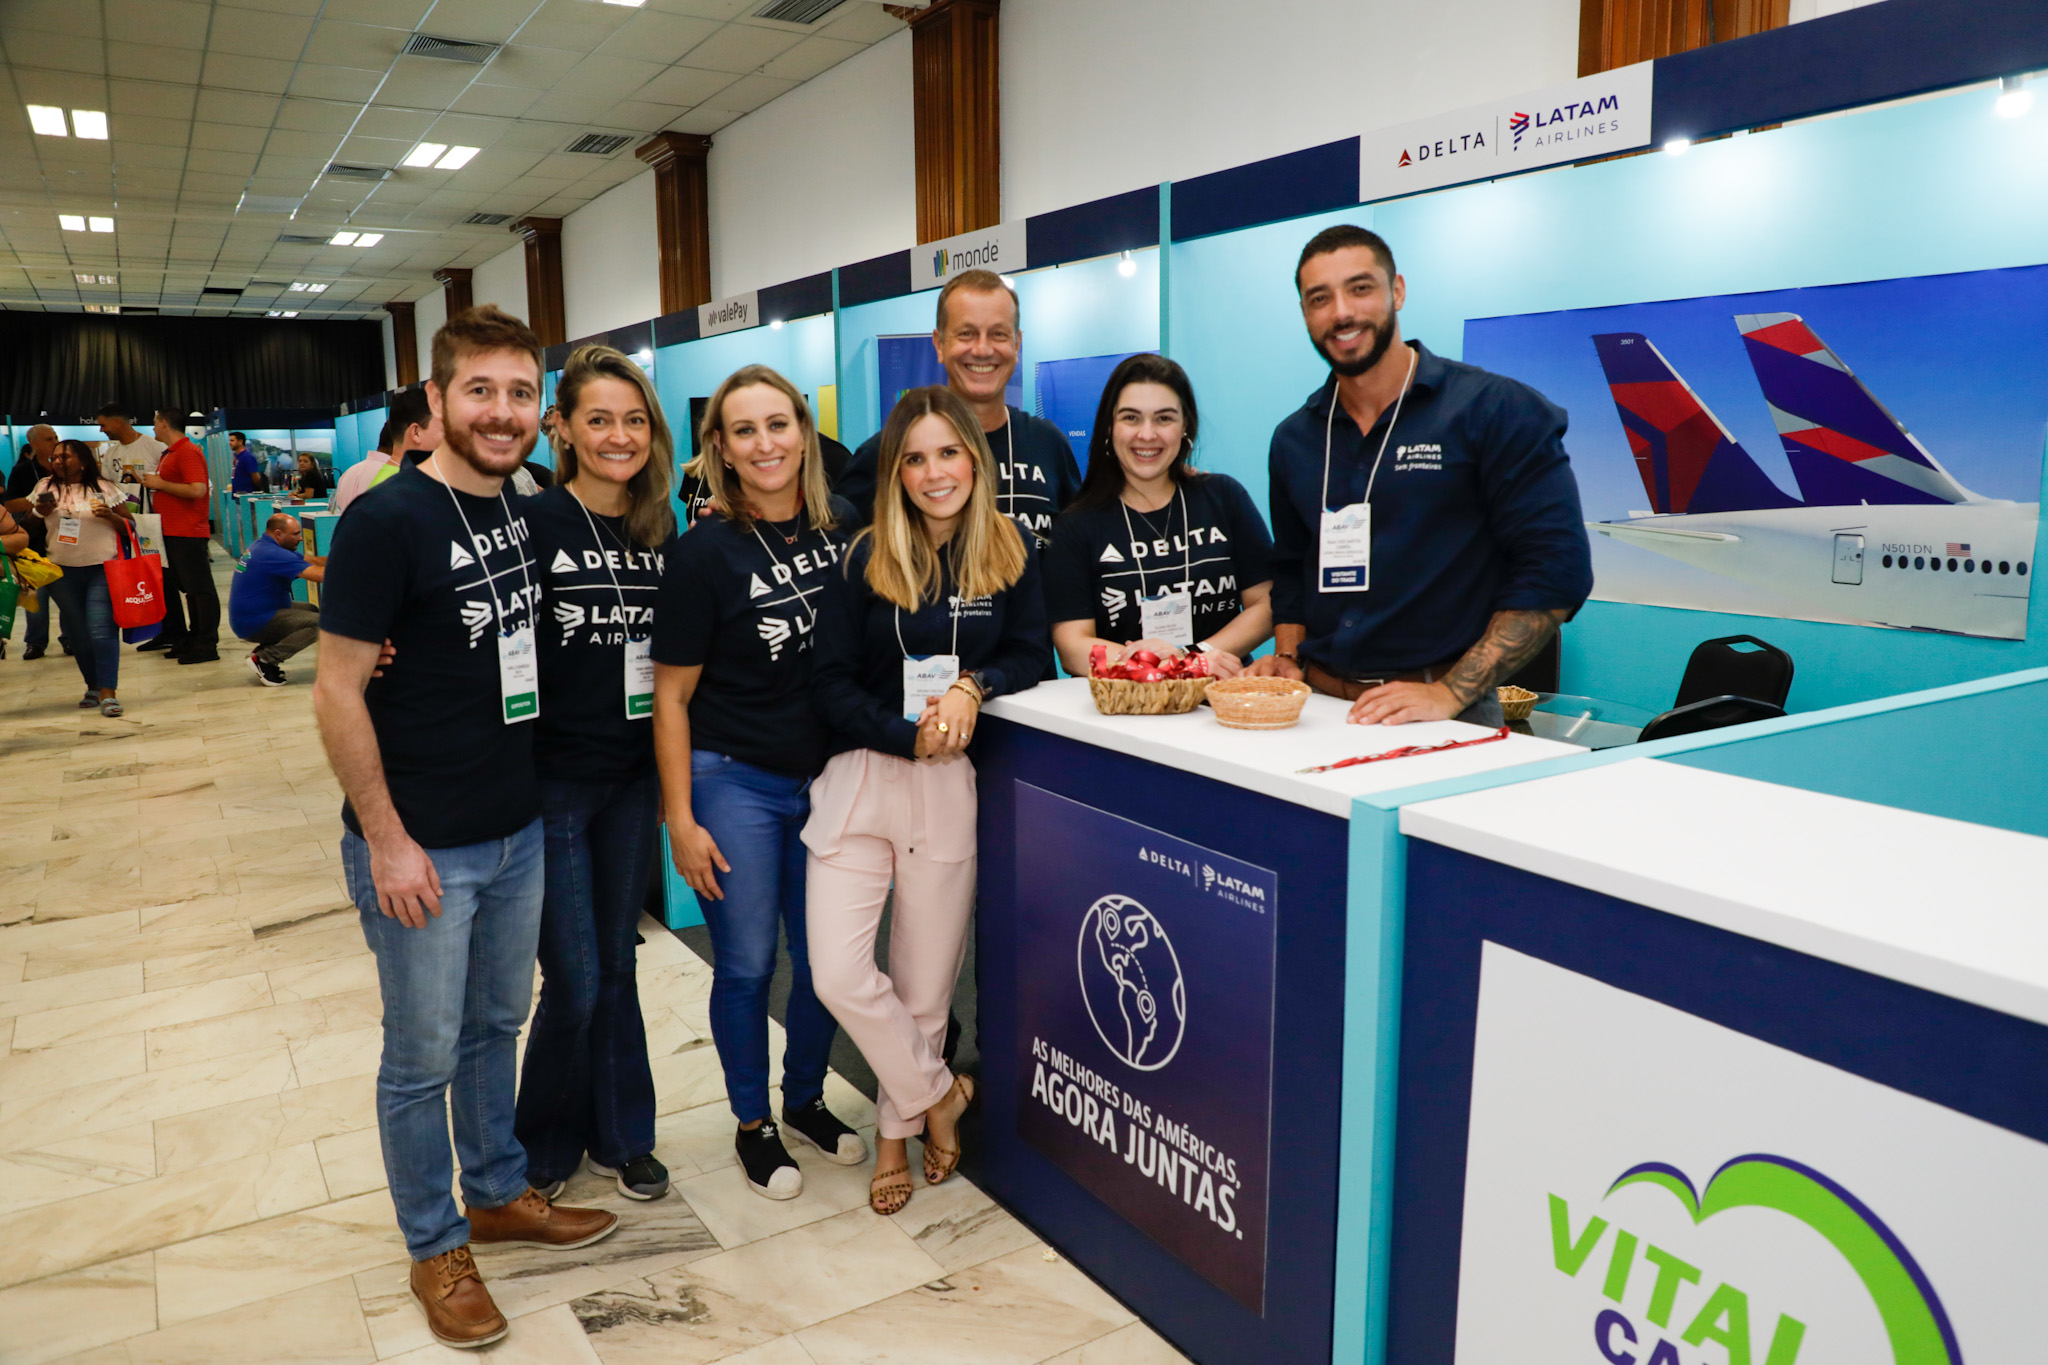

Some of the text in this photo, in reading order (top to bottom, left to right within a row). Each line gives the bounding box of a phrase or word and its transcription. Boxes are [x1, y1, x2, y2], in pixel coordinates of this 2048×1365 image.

[1535, 95, 1619, 128] LATAM
[1419, 131, 1485, 162] DELTA
[1535, 119, 1619, 148] AIRLINES
[952, 240, 999, 271] monde
[717, 301, 748, 324] valePay
[1068, 430, 1087, 438] VENDAS
[1406, 453, 1442, 461] AIRLINES
[1407, 444, 1442, 454] LATAM
[999, 462, 1046, 484] LTA
[1130, 526, 1228, 559] DELTA
[1882, 543, 1933, 555] N501DN
[582, 549, 666, 577] DELTA
[771, 542, 848, 586] DELT
[496, 582, 543, 619] LATA
[948, 610, 963, 618] Sm
[960, 600, 993, 609] AIRLINES
[590, 605, 655, 625] LATA
[1150, 850, 1191, 877] DELTA
[1216, 872, 1265, 901] LATAM
[1217, 889, 1265, 914] AIRLINES
[1032, 1036, 1242, 1190] AS MELHORES DAS AMÉRICAS,
[1031, 1061, 1243, 1241] AGORA JUNTAS.
